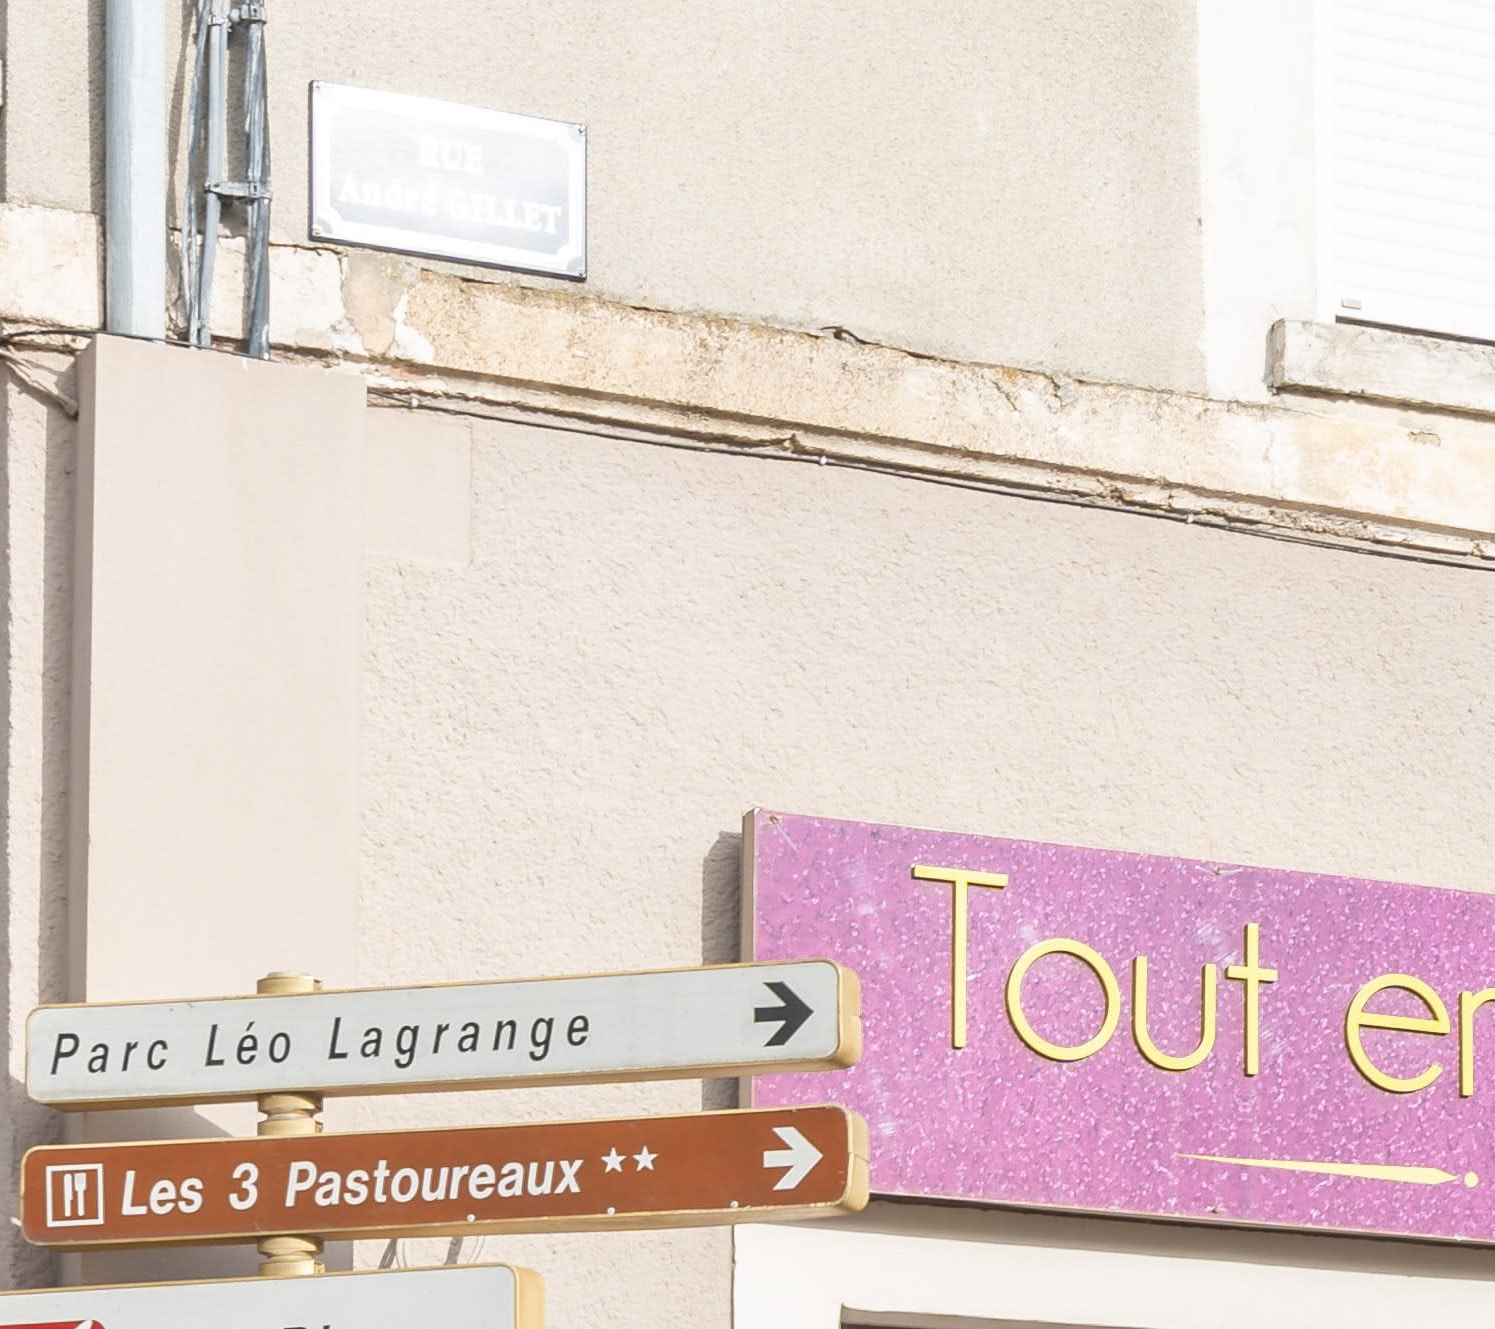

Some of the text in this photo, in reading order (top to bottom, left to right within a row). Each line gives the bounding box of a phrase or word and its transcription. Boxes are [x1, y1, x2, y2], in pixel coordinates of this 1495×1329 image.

[417, 135, 484, 176] RUE
[447, 192, 562, 234] GILLET
[911, 864, 1279, 1076] Tout
[50, 1012, 591, 1077] Parc Léo Lagrange
[121, 1152, 585, 1217] Les 3 Pastoureaux
